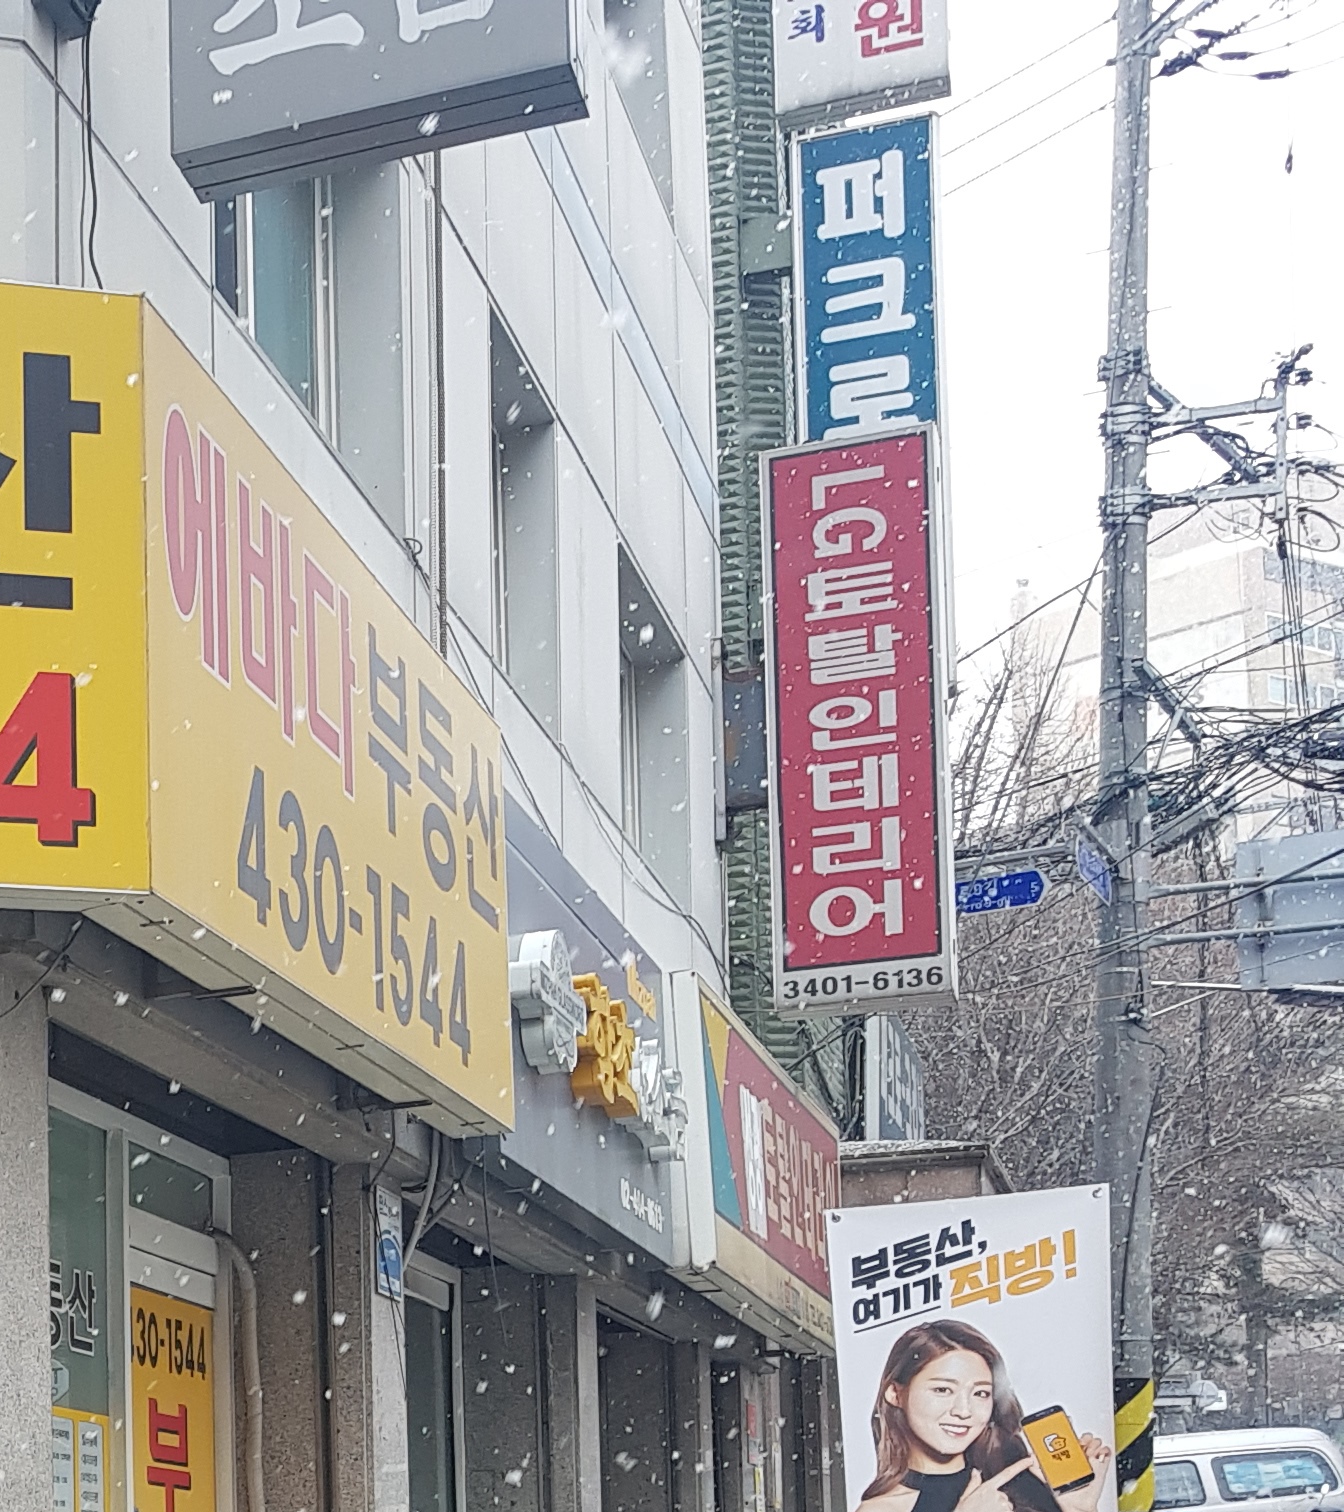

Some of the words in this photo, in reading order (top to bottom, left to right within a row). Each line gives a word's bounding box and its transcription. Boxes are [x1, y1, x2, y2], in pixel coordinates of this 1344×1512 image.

[162, 403, 356, 801] 에바다
[367, 621, 501, 932] 부동산
[237, 765, 472, 1069] 430-1544
[783, 966, 944, 999] 3401-6136
[851, 1218, 988, 1291] 부동산,
[853, 1274, 943, 1326] 여기가
[949, 1229, 1077, 1308] 직방!
[130, 1306, 206, 1381] 30-1544
